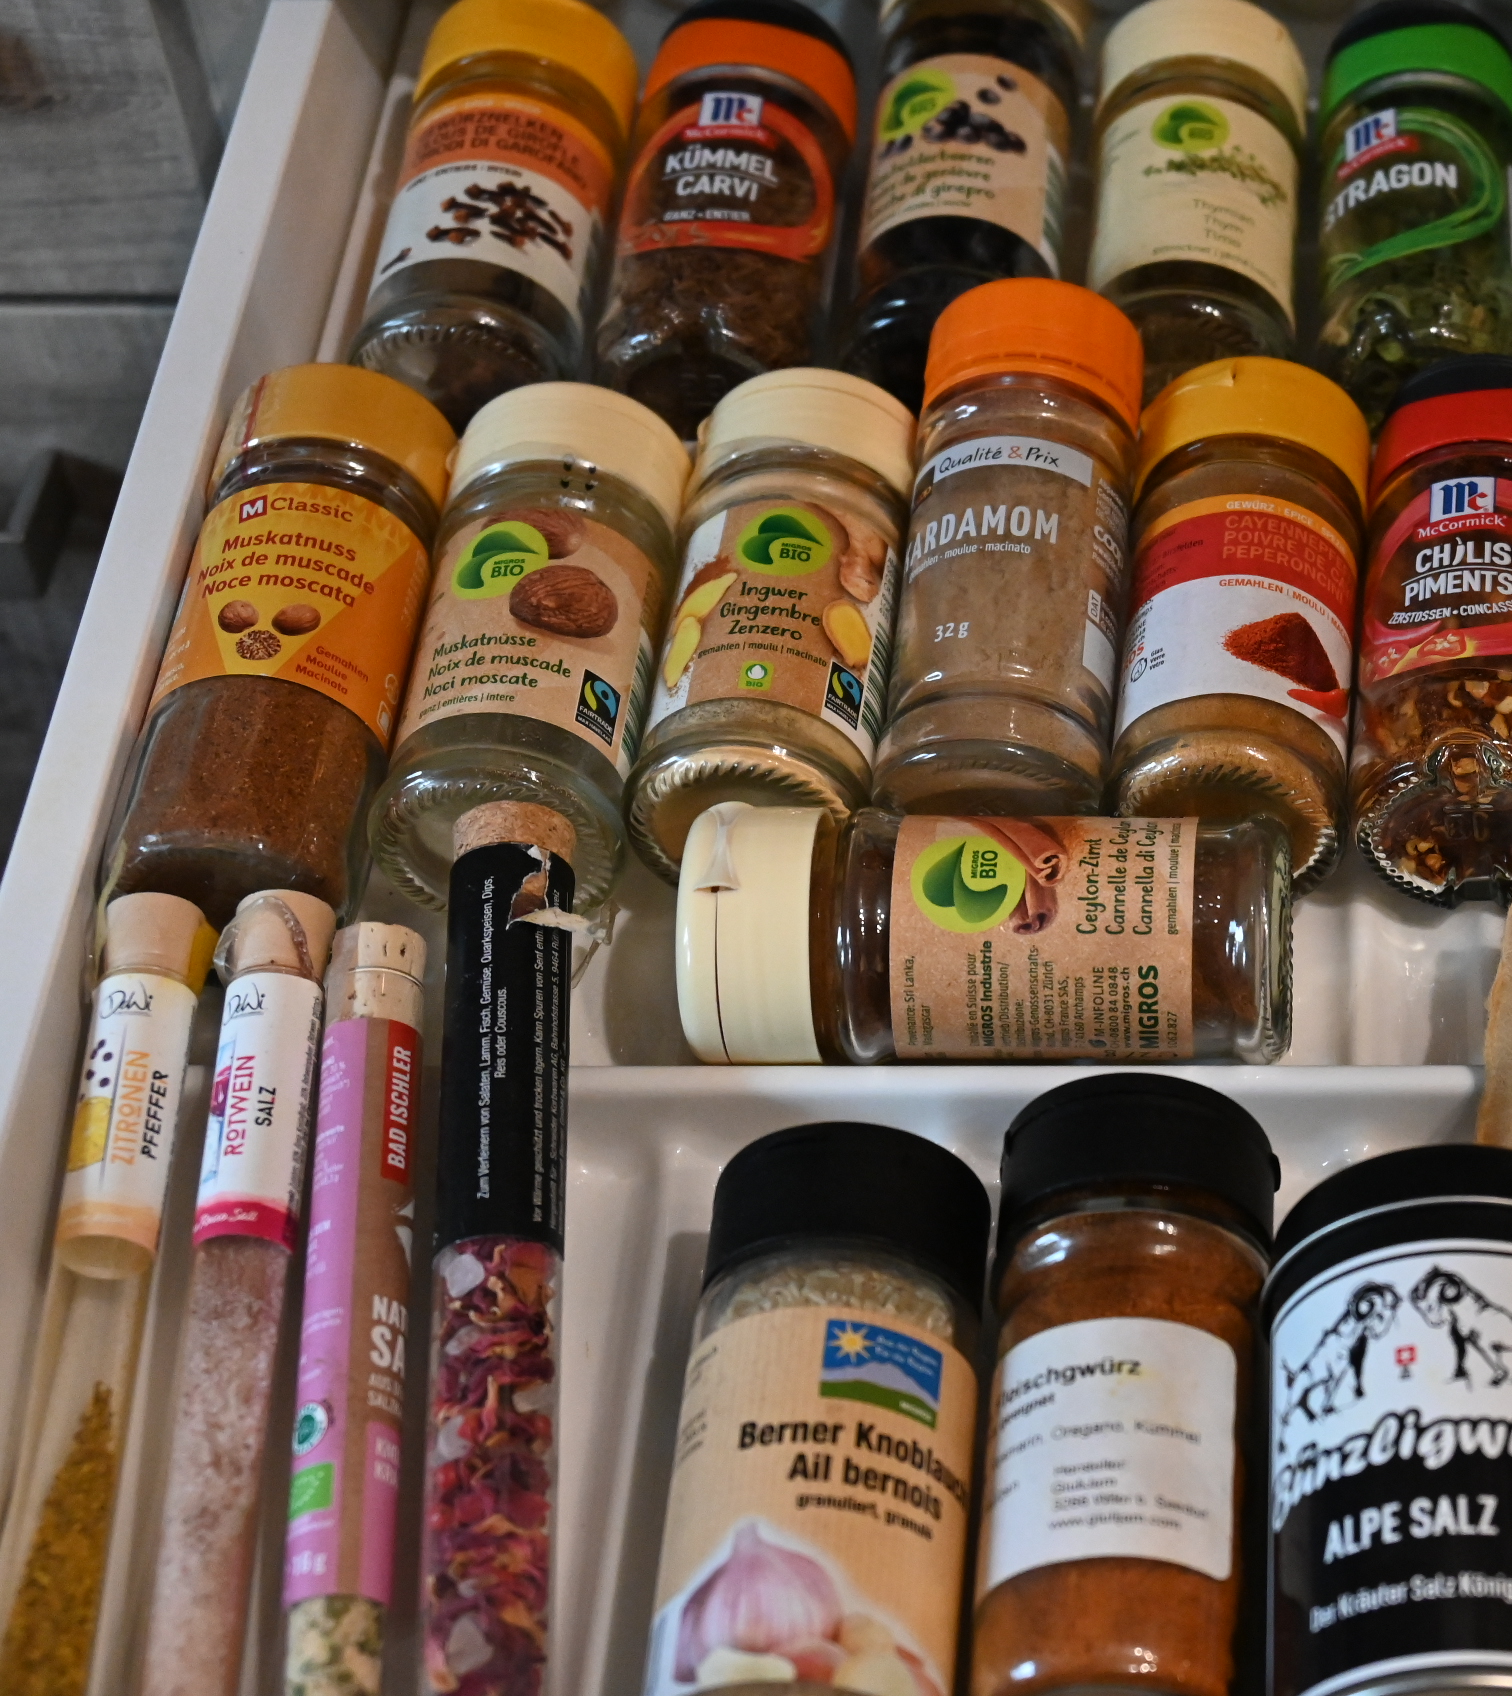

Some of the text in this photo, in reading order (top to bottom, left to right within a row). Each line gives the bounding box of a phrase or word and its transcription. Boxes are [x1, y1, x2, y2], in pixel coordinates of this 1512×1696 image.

[665, 143, 778, 183] KÜMMEL
[676, 175, 759, 202] CARVI
[939, 446, 1060, 474] Qualité & Prix
[270, 497, 355, 523] Classic
[1226, 499, 1275, 512] GEWÜRZ
[1417, 515, 1507, 539] McCormick
[222, 531, 357, 562] Muskatnuss
[779, 548, 811, 563] BIO
[944, 541, 1031, 560] moulue macinato
[1223, 530, 1300, 556] POIVRE
[1304, 549, 1328, 568] DE
[1415, 536, 1512, 574] CHILIS
[197, 552, 376, 595] Noix de muscade
[490, 565, 524, 579] BIO
[201, 573, 357, 608] Noce moscata
[740, 581, 808, 602] Ingwer
[1219, 578, 1326, 616] GEMAHLEN MOULU
[720, 602, 821, 627] Gingembre
[1387, 607, 1452, 625] ZERSTOSSEN
[728, 620, 803, 641] Zenzero
[934, 621, 970, 642] 32 g
[432, 632, 537, 661] Muskatnüsse
[786, 647, 828, 668] macinato
[295, 664, 349, 695] Macinata
[306, 654, 349, 682] Moulue
[316, 645, 370, 683] Gemahlen
[428, 651, 572, 680] Noix de muscade
[424, 673, 539, 700] Noci moscate
[442, 692, 515, 708] entières intere
[579, 706, 614, 734] FAIRTRADE
[970, 850, 980, 879] MIGROS
[980, 849, 998, 880] BIO
[1075, 838, 1106, 935] Ceylon-Zimt
[1105, 847, 1128, 936] Cannelle de
[1132, 849, 1156, 936] Cannella di
[1166, 886, 1179, 935] gemahlen
[904, 955, 917, 988] Lanka,
[966, 953, 979, 976] pour
[1041, 961, 1054, 991] Zürich
[478, 875, 495, 1107] Salaten, Lamm, Fisch, Gemüse, Quarkspeisen, Dips,
[533, 950, 545, 1044] Kann Spuren Senf
[967, 983, 977, 1009] Suisse
[979, 940, 995, 1048] MIGROS Industrie
[1058, 976, 1071, 998] SAS,
[1074, 976, 1086, 1021] Archamps
[1107, 967, 1118, 1013] 84 0848
[1138, 965, 1160, 1049] MIGROS
[493, 986, 507, 1078] Reis oder Couscous.
[111, 1050, 151, 1167] ZITRONEN
[141, 1070, 169, 1161] PFEFFER
[224, 1055, 257, 1157] ROTWEIN
[256, 1086, 277, 1127] SALZ
[387, 1045, 413, 1170] BAD ISCHLER
[1001, 1356, 1141, 1407] leischgwürz
[738, 1421, 843, 1451] Berner
[789, 1452, 942, 1520] Ail bernois
[1323, 1493, 1500, 1565] ALPE SALZ
